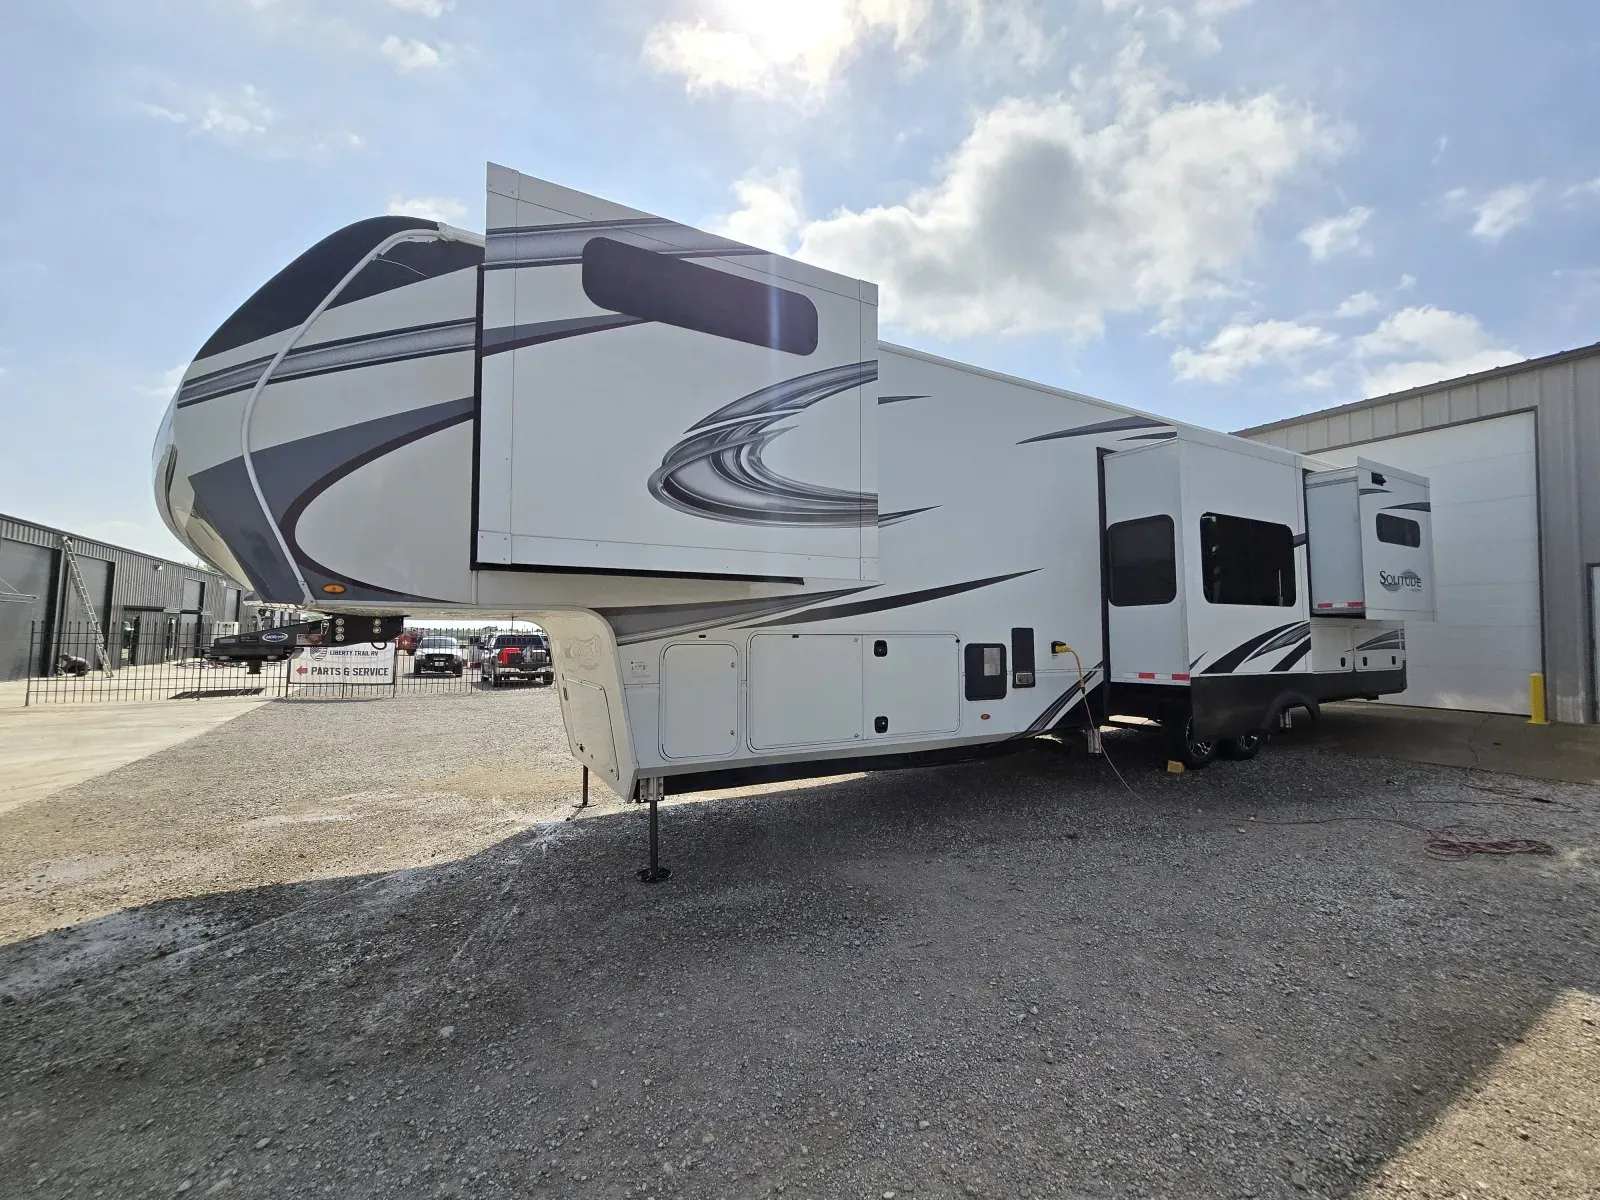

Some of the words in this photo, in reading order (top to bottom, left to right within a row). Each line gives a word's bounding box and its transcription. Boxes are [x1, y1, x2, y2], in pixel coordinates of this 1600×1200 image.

[1379, 570, 1422, 588] SOLITUDE
[354, 649, 370, 657] TRAIL
[311, 666, 341, 676] PARTS
[343, 667, 350, 676] &
[352, 667, 389, 676] SERVICE
